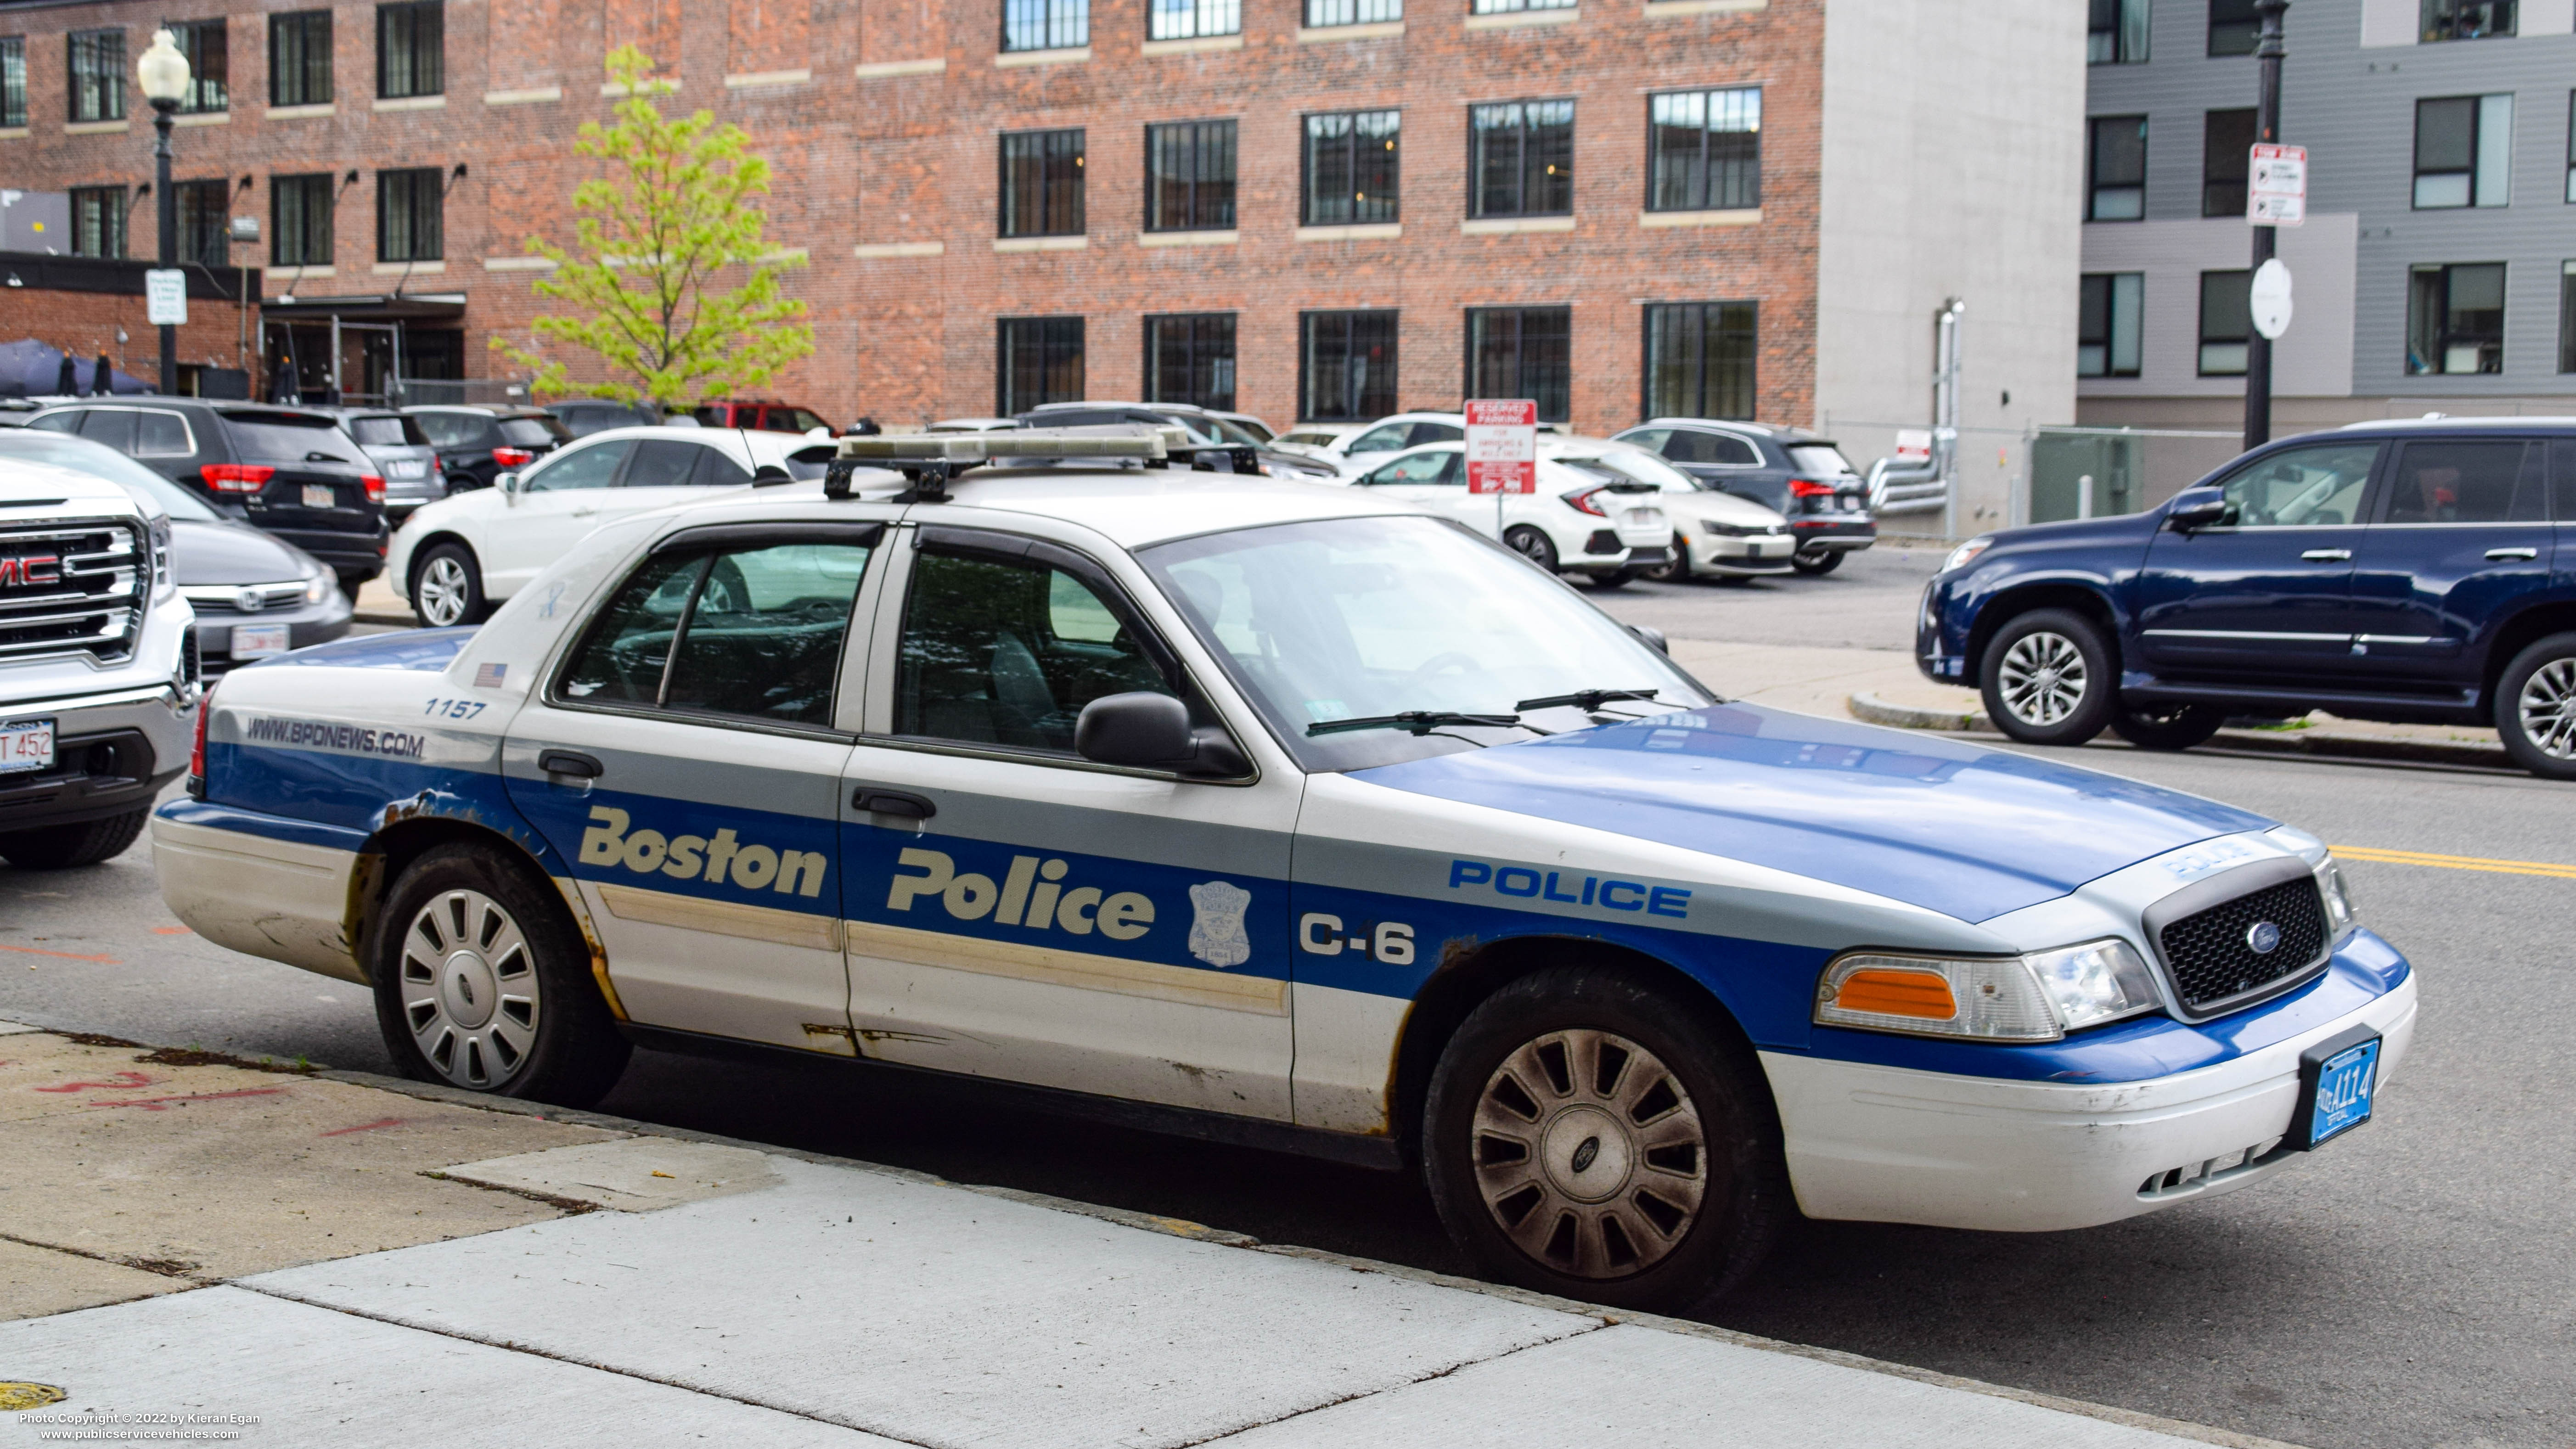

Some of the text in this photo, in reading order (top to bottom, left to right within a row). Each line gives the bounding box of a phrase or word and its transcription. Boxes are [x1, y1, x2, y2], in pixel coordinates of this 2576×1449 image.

[1477, 415, 1524, 424] PARKING
[425, 698, 487, 719] 1157
[0, 731, 51, 760] T 452
[248, 717, 425, 758] WWW.BPDNEWS.COM
[579, 805, 1155, 940] Boston Police
[1449, 860, 1692, 918] POLICE
[1299, 912, 1415, 965] C-6
[2331, 1061, 2374, 1112] A114
